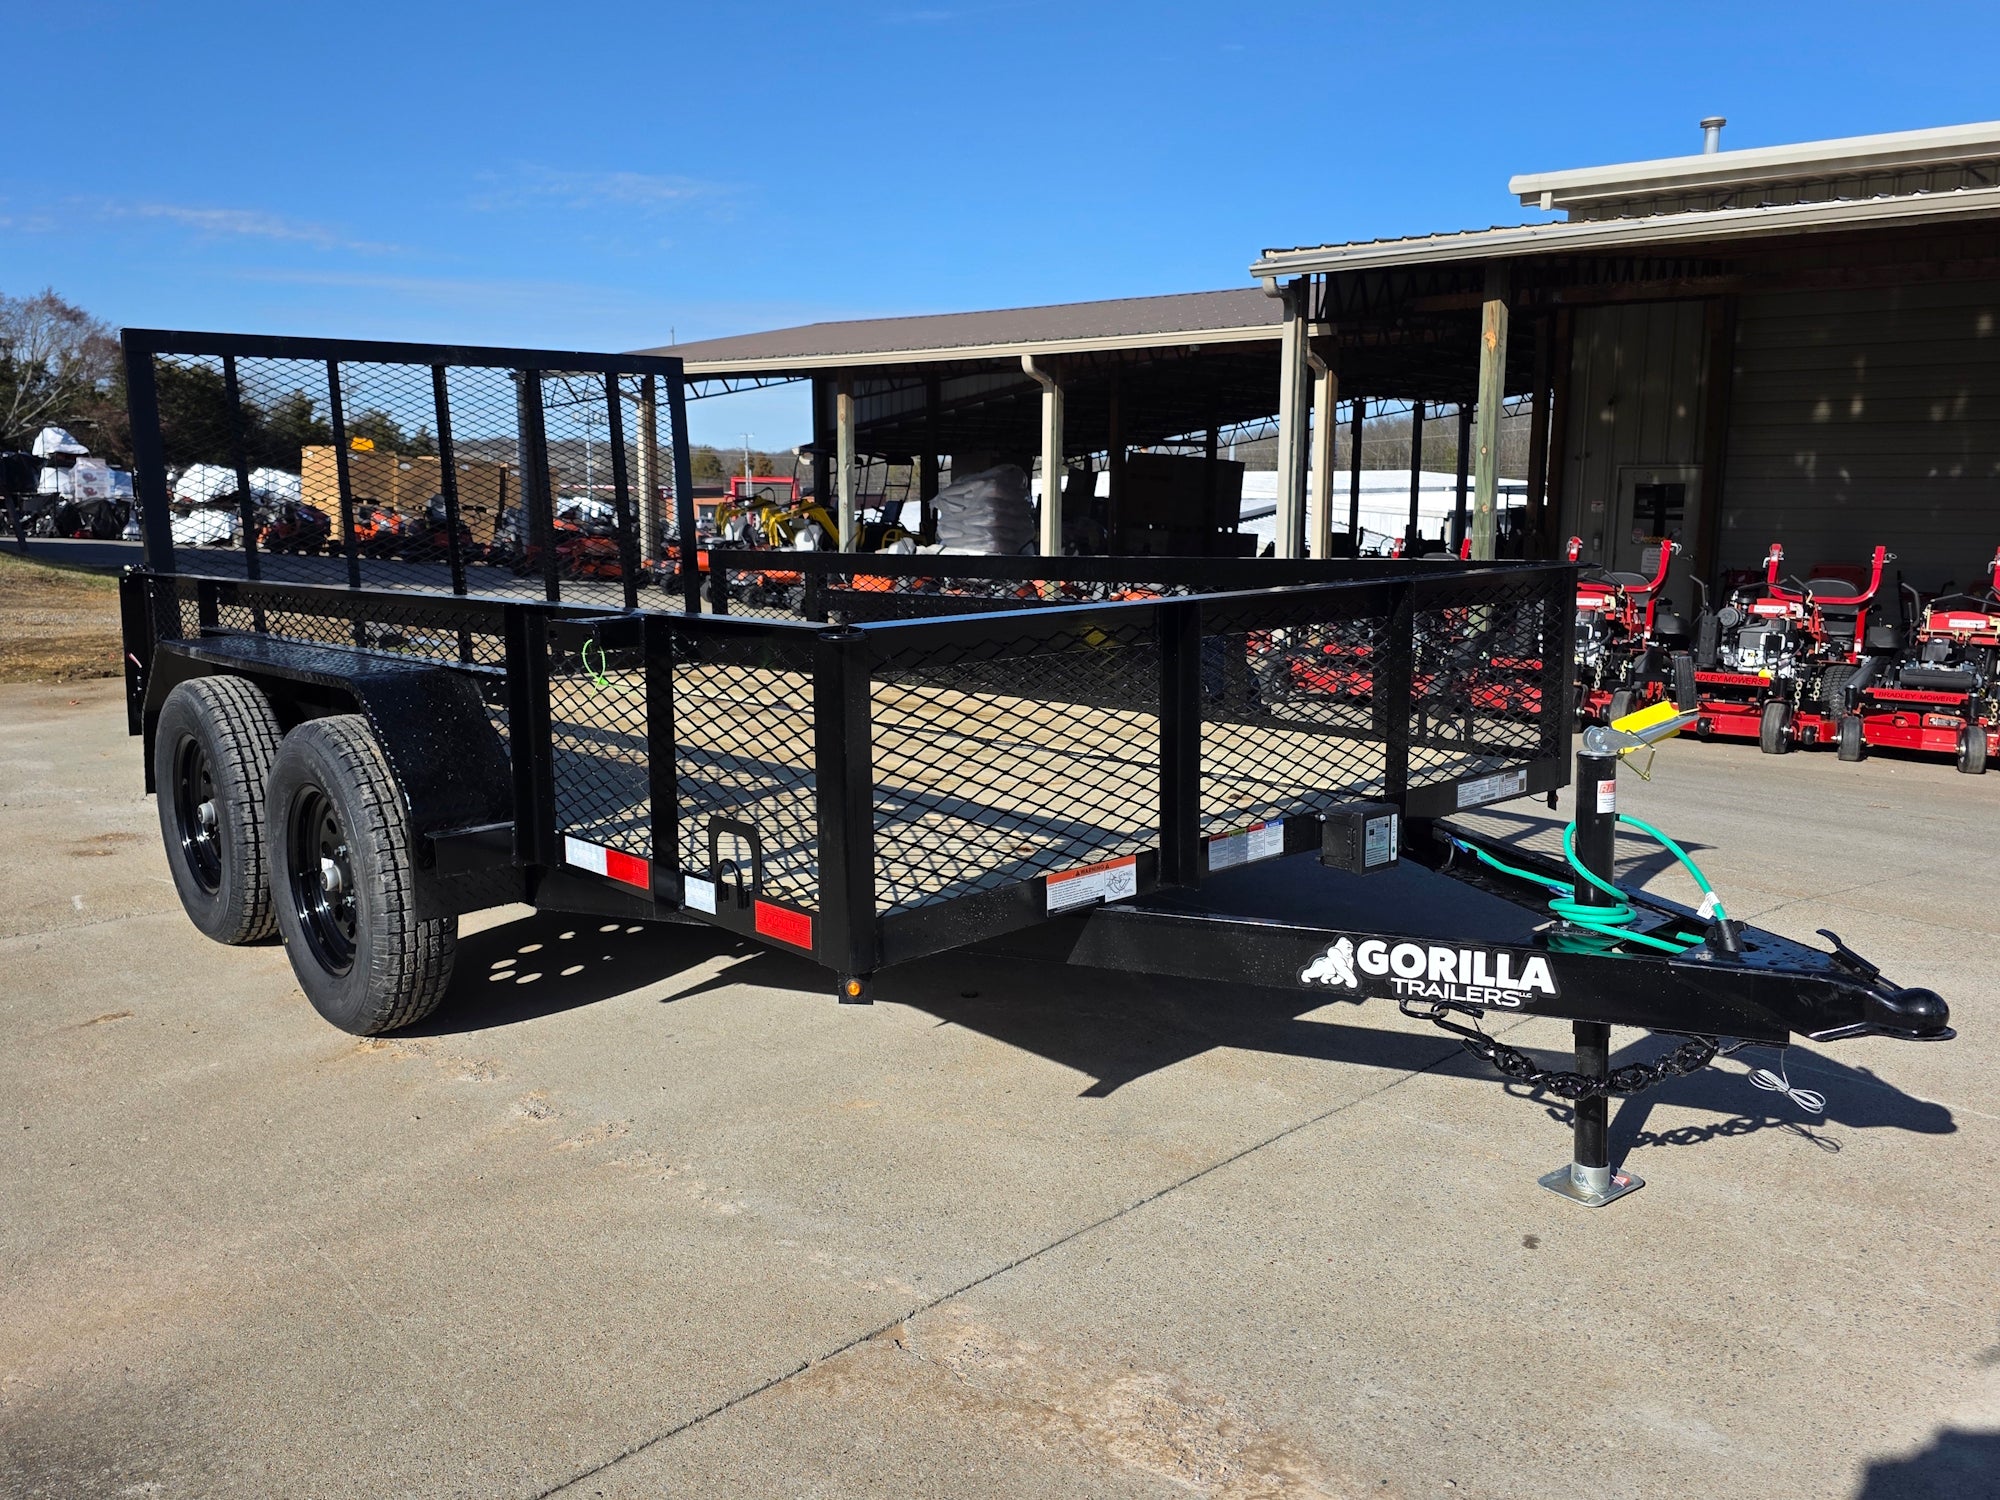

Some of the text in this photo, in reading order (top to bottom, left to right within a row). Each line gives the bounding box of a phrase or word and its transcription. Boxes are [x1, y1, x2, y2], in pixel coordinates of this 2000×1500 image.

[1723, 675, 1764, 685] MOWERS
[1878, 691, 1959, 703] BRADLEY MOWERS
[1357, 939, 1556, 994] GORILLA
[1390, 977, 1521, 1007] TRAILERS
